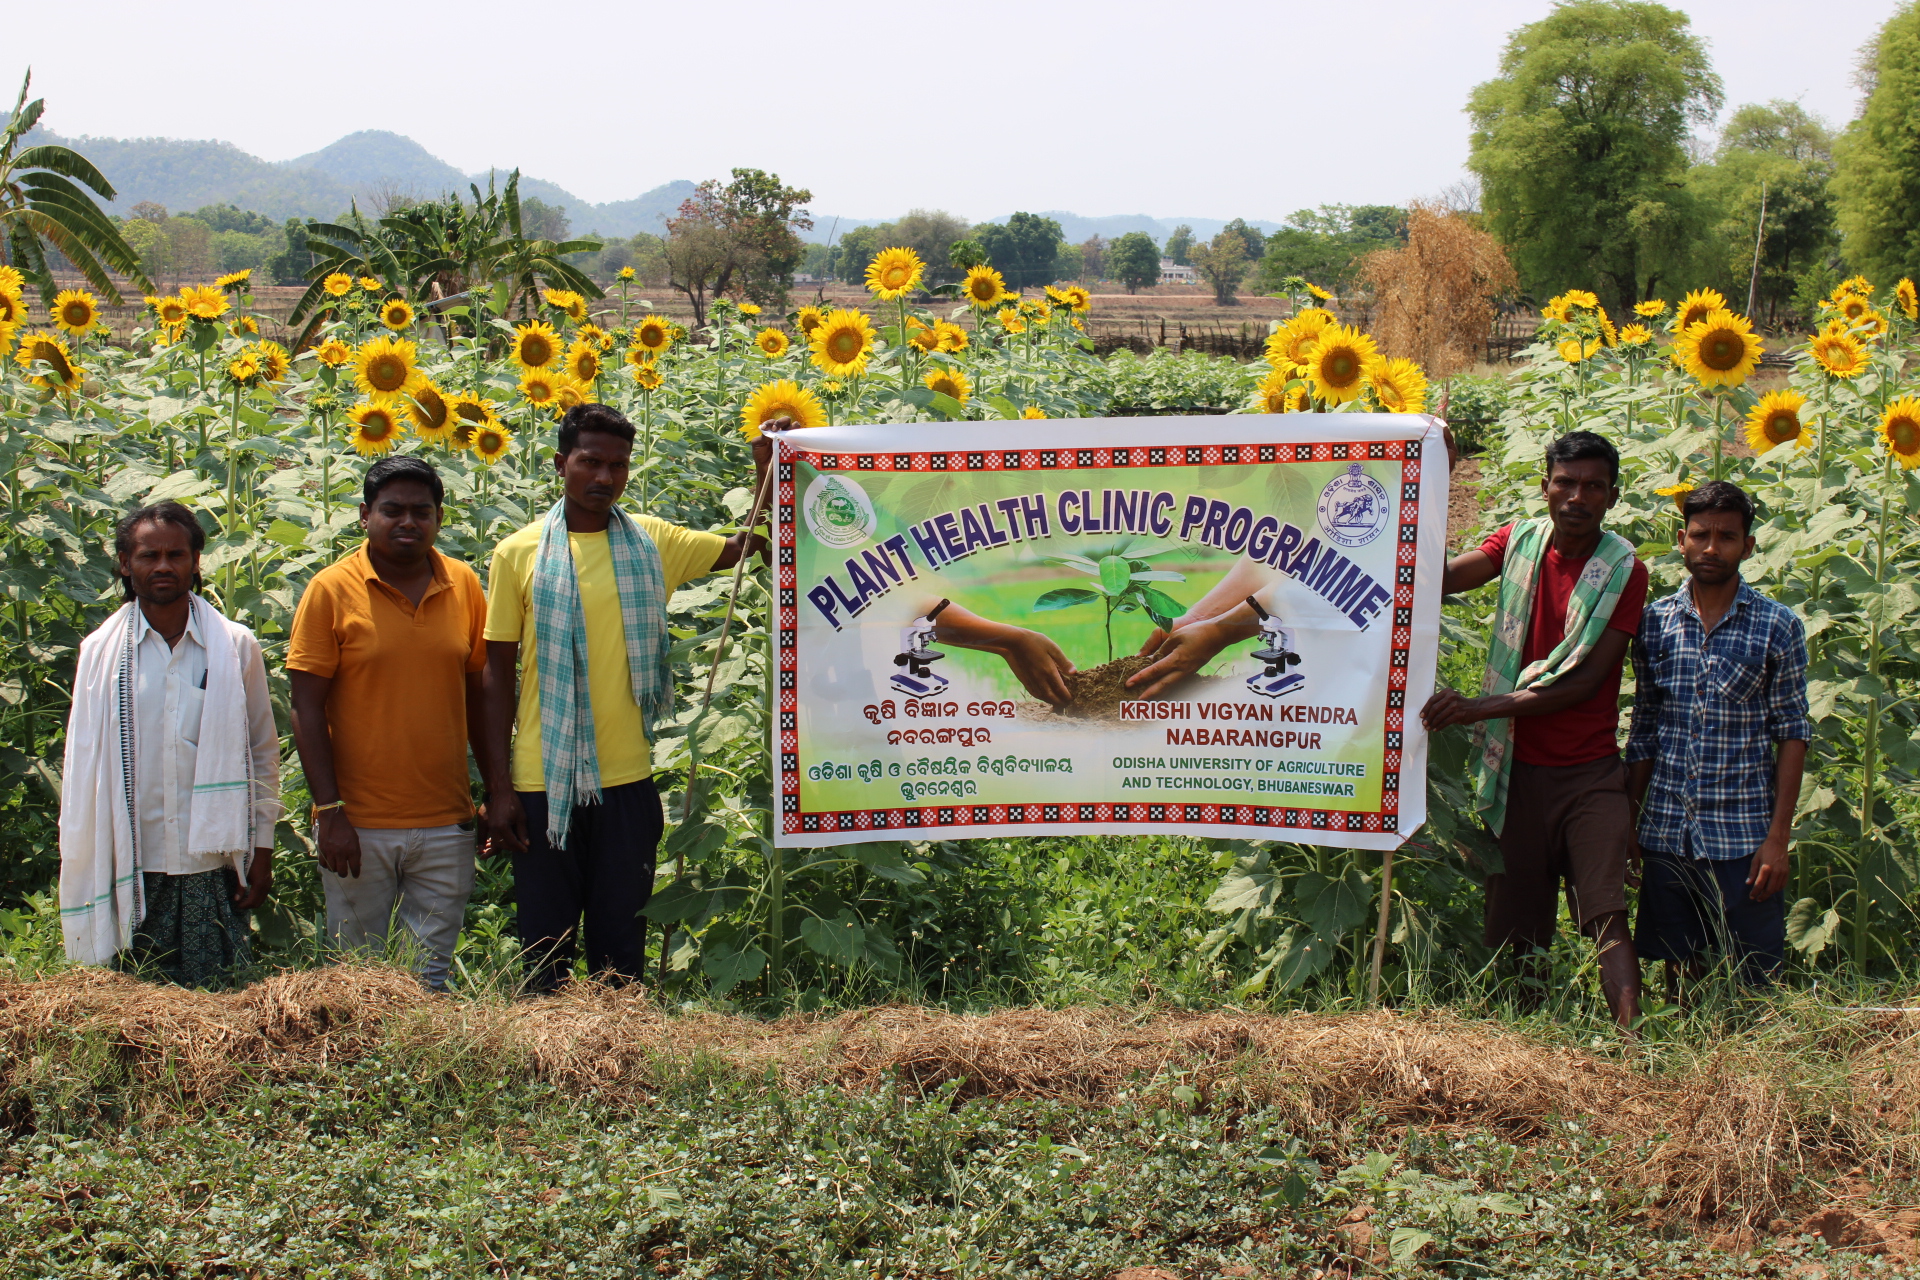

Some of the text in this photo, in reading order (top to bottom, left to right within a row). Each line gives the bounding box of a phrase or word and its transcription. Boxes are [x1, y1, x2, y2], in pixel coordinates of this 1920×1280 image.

[807, 532, 918, 633] PLANT
[909, 494, 1051, 571] HEALTH
[1058, 489, 1176, 538] CLINIC
[1179, 495, 1393, 632] PROGRAMME
[1121, 702, 1358, 725] KRISHI VIGYAN KENDRA
[1166, 728, 1321, 750] NABARANGPUR
[1112, 757, 1365, 777] ODISHA UNIVERSITY OF AGRICULTURE
[1122, 777, 1354, 797] AND TECHNOLOGY, BHUBANESWAR
